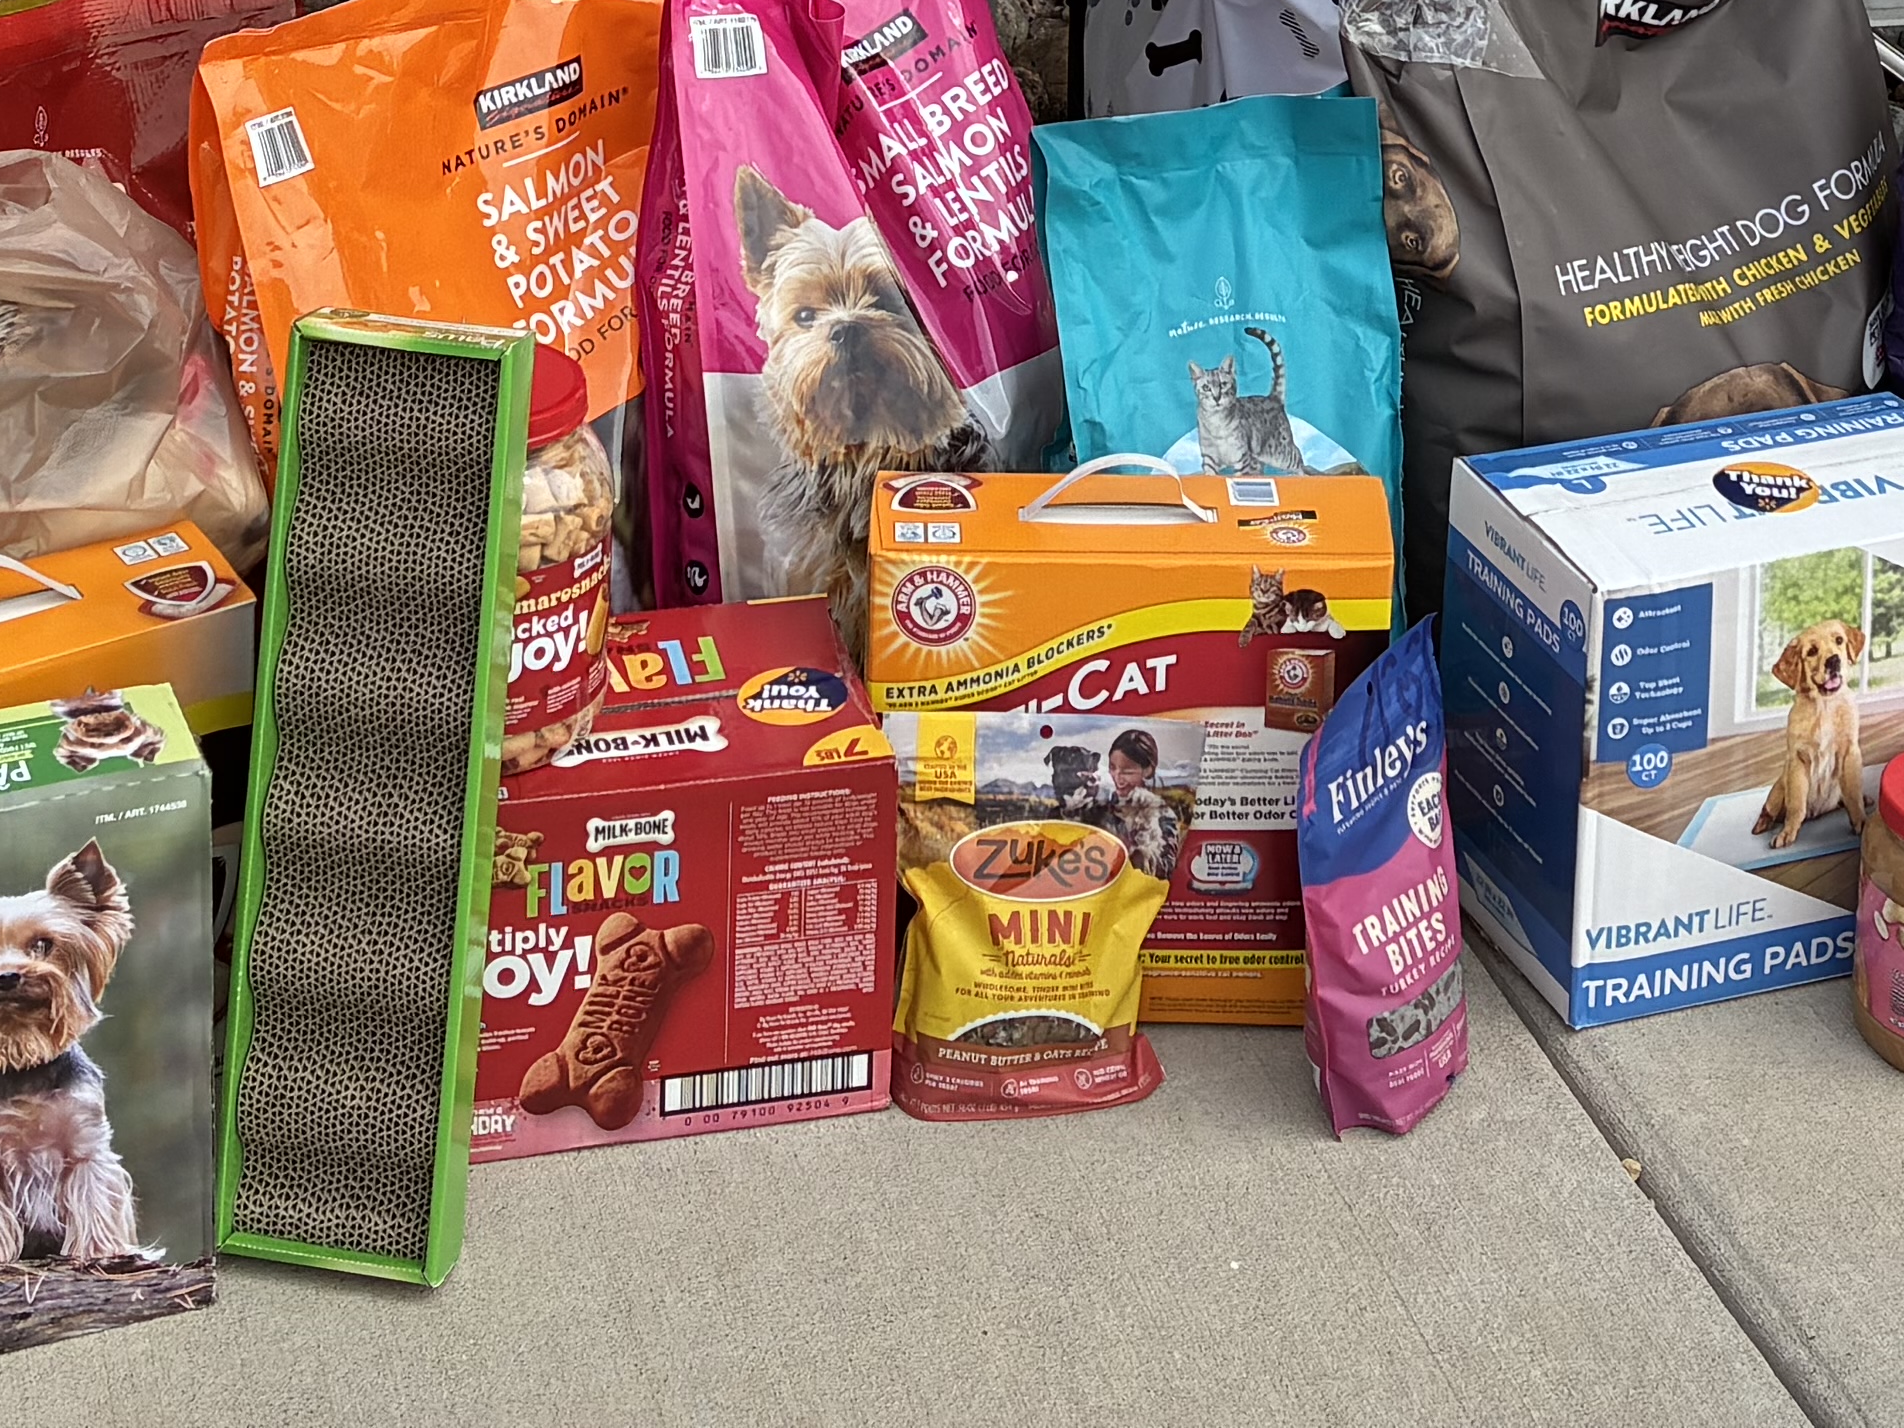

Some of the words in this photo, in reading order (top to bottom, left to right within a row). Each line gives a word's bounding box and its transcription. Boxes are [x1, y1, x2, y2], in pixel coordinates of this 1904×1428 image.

[479, 61, 581, 114] KIRKLAND
[441, 125, 546, 176] NATURE'S
[556, 92, 622, 134] DOMAIN
[891, 108, 1012, 207] SALMON
[476, 139, 606, 228] SALMON
[492, 235, 520, 269] &
[526, 177, 622, 254] SWEET
[1740, 193, 1810, 247] DOG
[506, 211, 638, 308] POTATO
[896, 578, 920, 615] ARM
[928, 568, 972, 618] HAMMER
[1466, 549, 1524, 621] TRAINING
[1526, 612, 1562, 653] PADS
[886, 684, 939, 700] EXTRA
[945, 663, 1020, 695] AMMONIA
[934, 770, 956, 779] USA
[1327, 721, 1427, 824] Finley's
[1631, 751, 1668, 771] 100
[527, 850, 680, 918] FLAVOR
[974, 839, 1110, 888] Zuke's
[988, 910, 1094, 946] MINI
[1353, 865, 1448, 956] TRAINING
[1585, 910, 1711, 951] VIBRANT
[1714, 897, 1768, 930] LIFE
[1386, 912, 1446, 976] BITES
[1582, 956, 1757, 1009] TRAINING
[1763, 933, 1854, 976] PADS
[939, 1048, 987, 1064] PEANUT
[990, 1052, 1032, 1065] BUTTER
[1044, 1048, 1073, 1059] OATS
